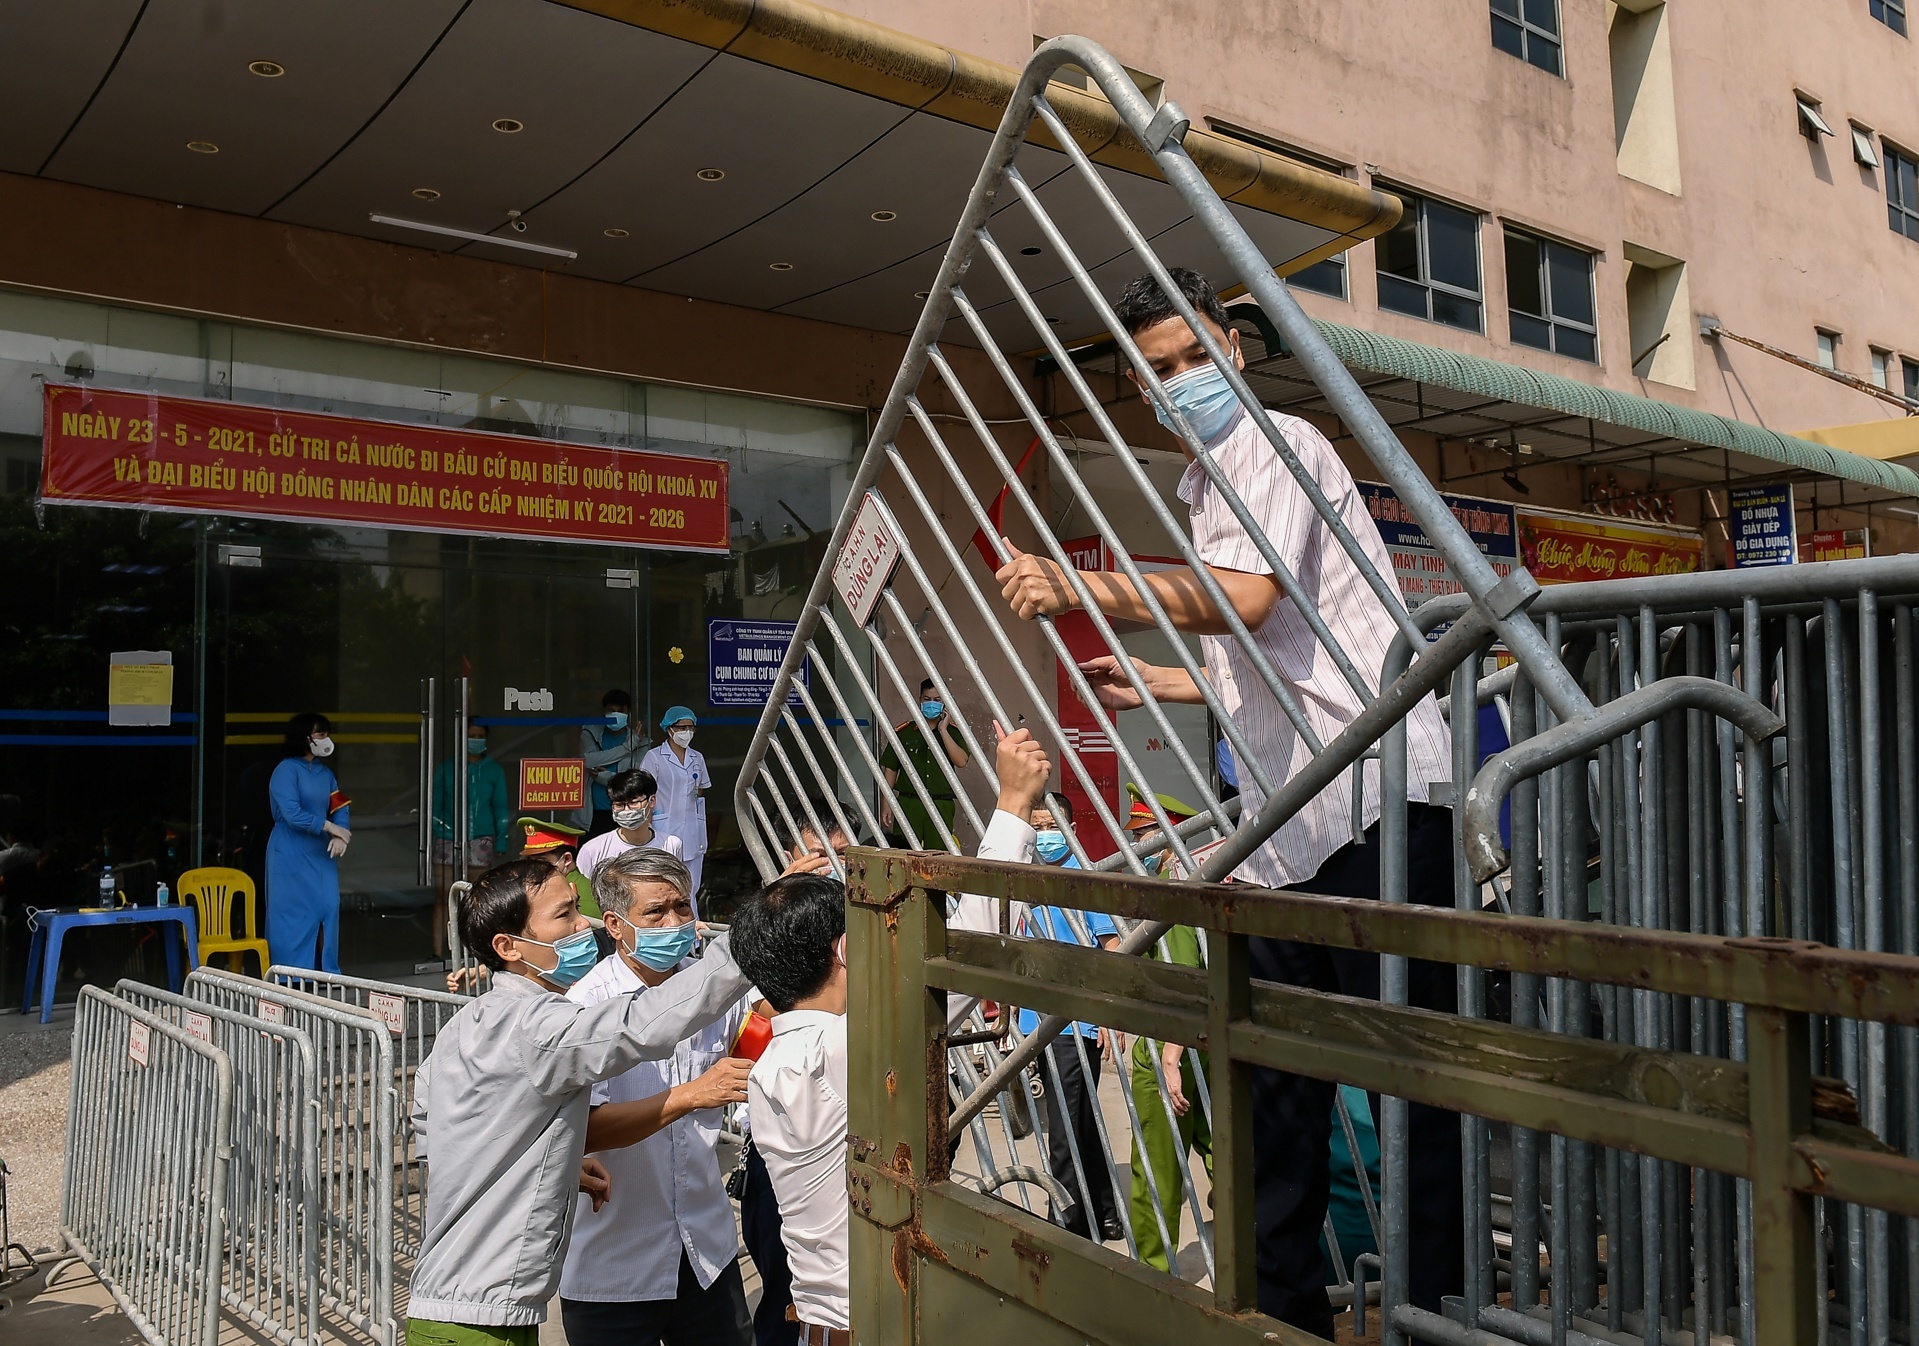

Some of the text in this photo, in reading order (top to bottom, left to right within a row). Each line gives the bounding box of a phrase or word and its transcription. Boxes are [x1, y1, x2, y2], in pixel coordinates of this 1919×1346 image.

[62, 411, 121, 440] NGÀY
[128, 419, 153, 443] 23
[175, 424, 187, 446] 5
[208, 427, 262, 457] 2021,
[269, 428, 297, 458] CỬ
[301, 437, 329, 461] TRI
[336, 436, 361, 464] CẢ
[366, 443, 415, 470] NƯỚC
[420, 450, 438, 472] ĐI
[443, 447, 478, 477] BẦU
[483, 451, 506, 479] CỬ
[510, 459, 537, 485] ĐẠI
[542, 457, 578, 487] BIỂU
[583, 463, 624, 493] QUỐC
[628, 469, 653, 497] HỘI
[657, 474, 696, 499] KHOÁ
[699, 479, 718, 500] XV
[114, 454, 140, 483] VÀ
[148, 460, 183, 490] ĐẠI
[190, 457, 236, 490] BIỂU
[243, 466, 275, 498] HỘI
[281, 467, 334, 500] ĐỒNG
[340, 477, 392, 505] NHÂN
[397, 481, 434, 508] DÂN
[439, 486, 474, 511] CÁC
[478, 485, 512, 515] CẤP
[517, 494, 570, 524] NHIỆM
[574, 497, 594, 523] KỲ
[598, 504, 634, 526] 2021
[649, 508, 685, 530] 2026
[1537, 538, 1574, 569] Chúc
[1749, 538, 1764, 550] GIA
[1765, 536, 1790, 549] DỤNG
[1067, 548, 1098, 570] TM
[1393, 550, 1417, 570] MÁY
[1420, 553, 1445, 573] TÍNH
[738, 644, 782, 663] BAN QUẢN LÝ
[715, 666, 732, 682] CỤM
[733, 666, 757, 680] CHUNG
[758, 666, 769, 680] CƯ
[504, 687, 553, 711] Push
[526, 765, 581, 787] KHU VỰC
[526, 788, 579, 803] CÁCH LY Y TẾ
